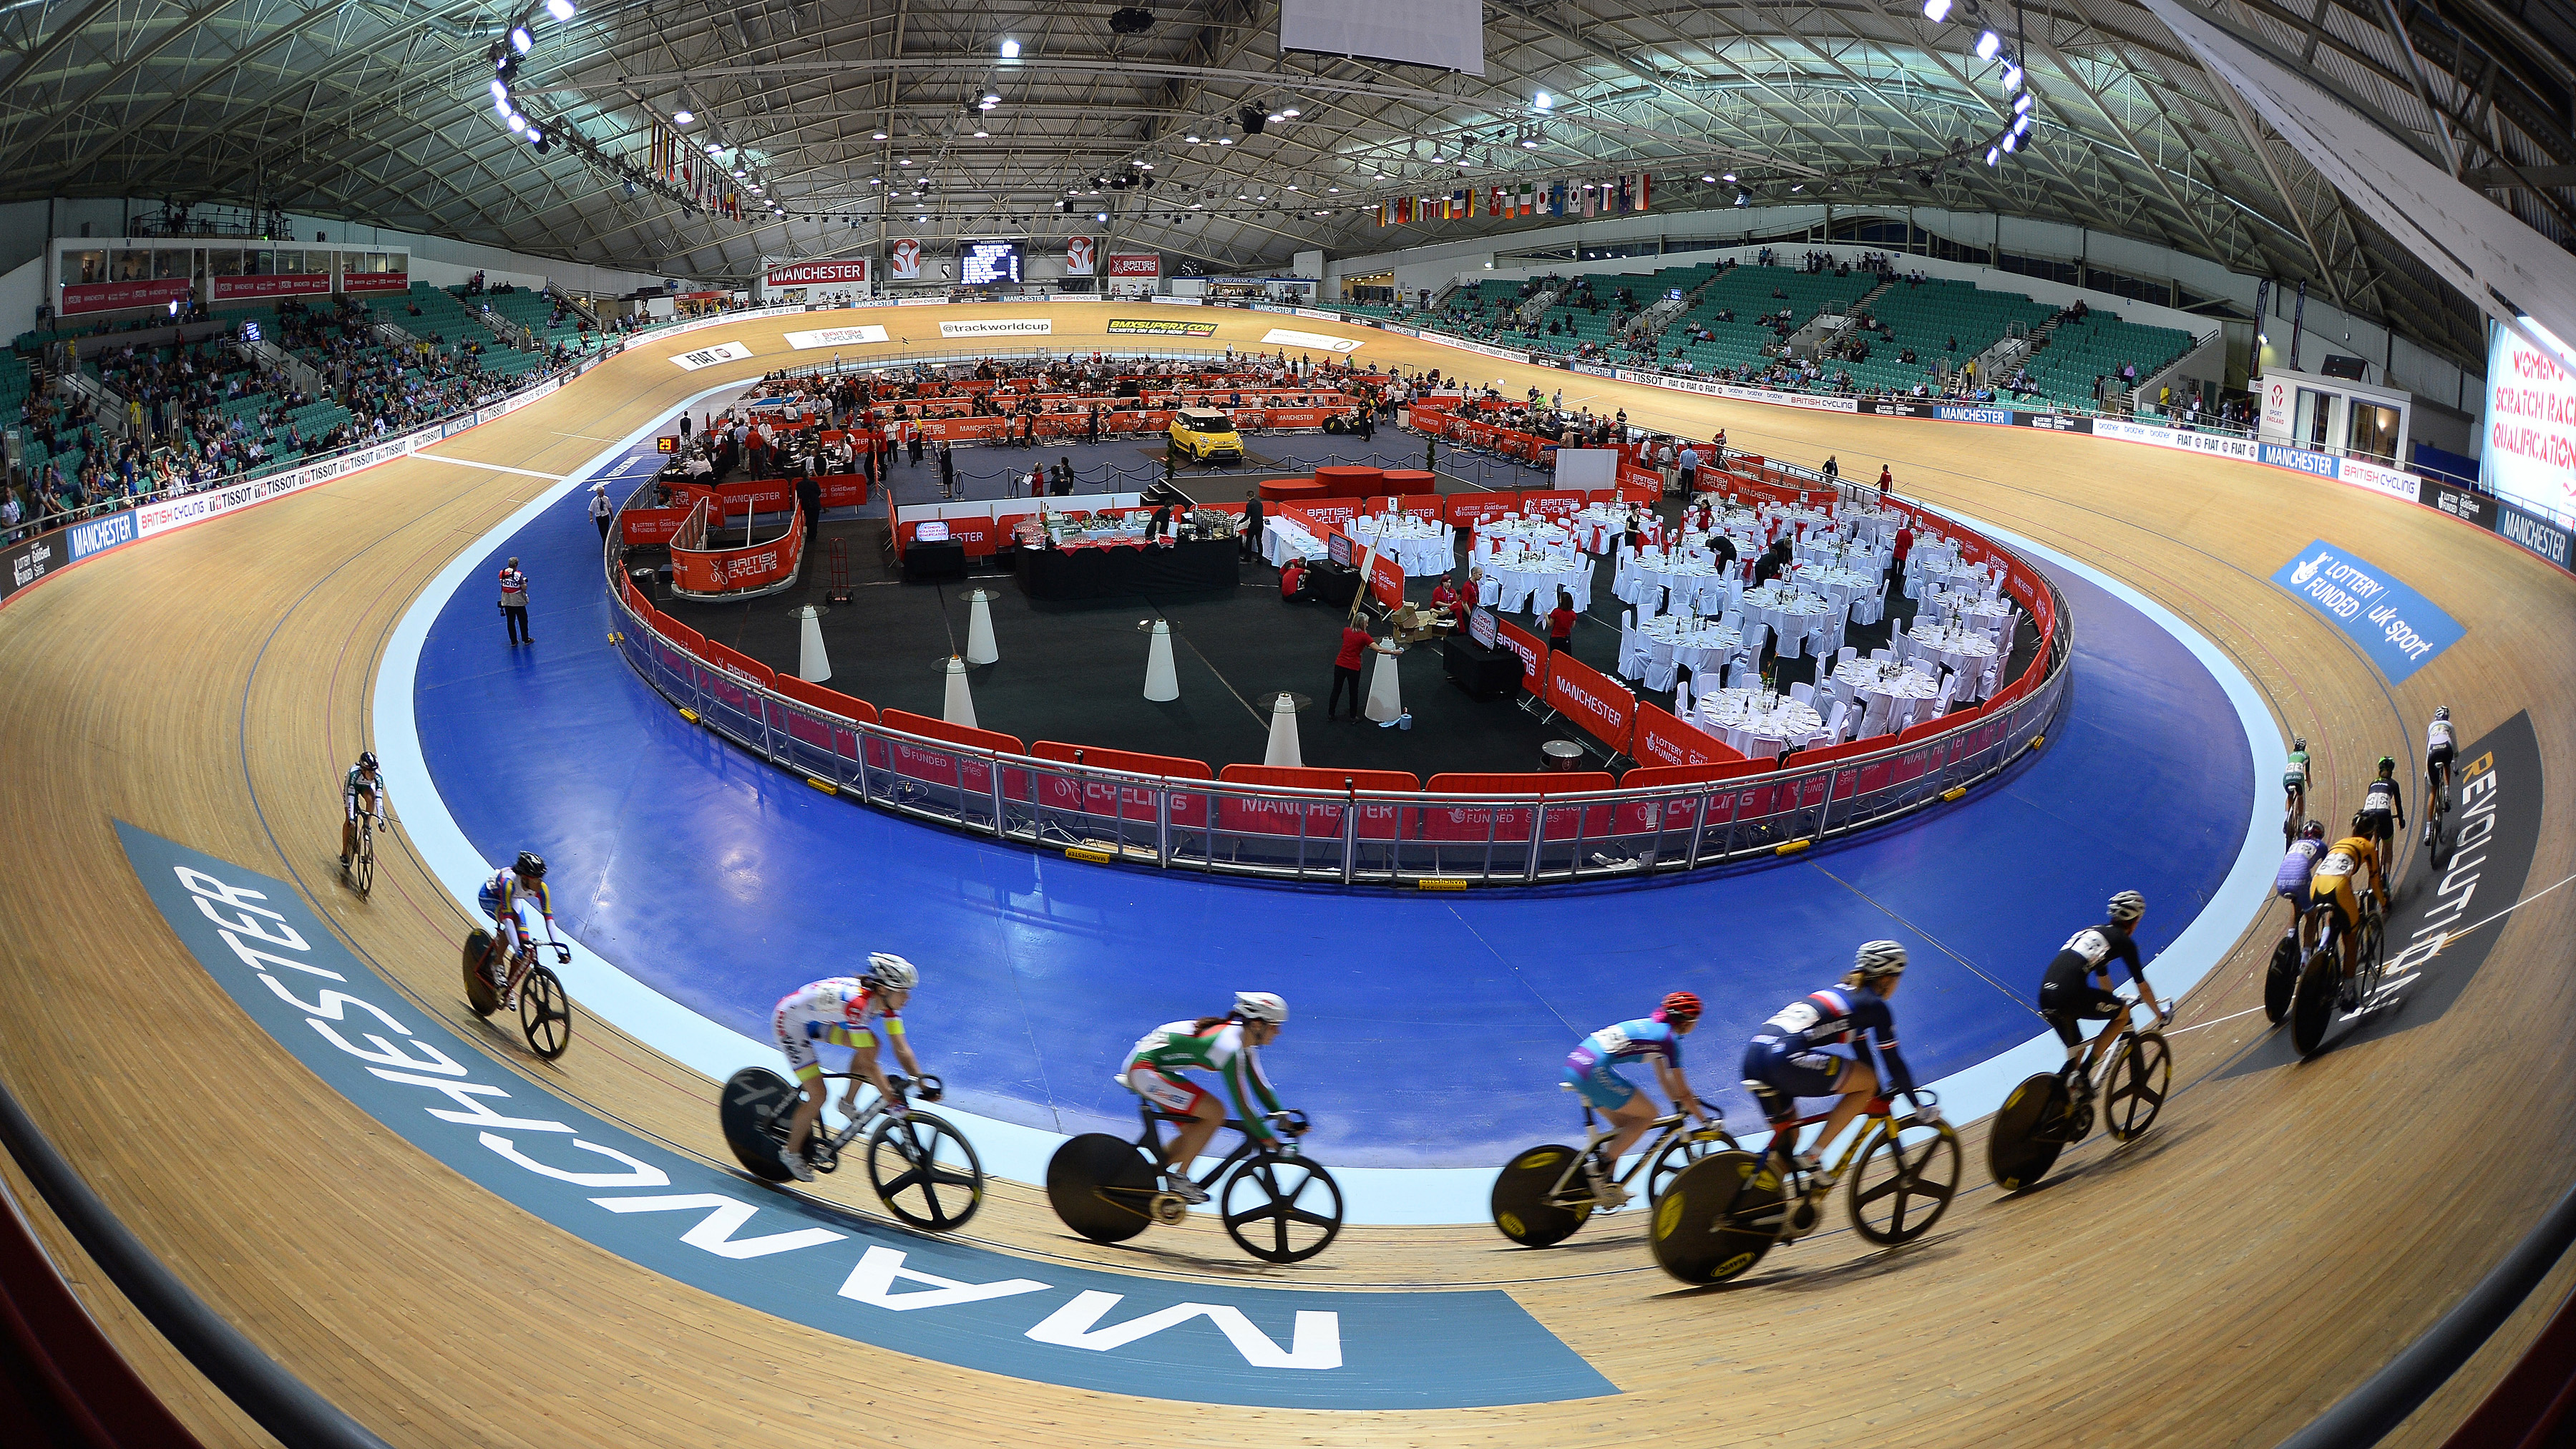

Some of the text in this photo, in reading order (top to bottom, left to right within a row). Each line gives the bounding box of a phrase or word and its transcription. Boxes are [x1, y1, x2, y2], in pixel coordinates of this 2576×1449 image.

[772, 265, 860, 281] MANCHESTER
[1254, 304, 1292, 313] MANCHESTER
[669, 326, 684, 336] TISSOT
[943, 323, 1049, 332] @trackworldcup
[1111, 321, 1215, 331] BMXSUPERX.COM
[1385, 323, 1416, 336] MANCHESTER
[1422, 333, 1438, 341] BRITISH
[686, 351, 717, 365] FIAT
[1462, 342, 1528, 361] TISSOT TISSOT TISSOT
[1574, 364, 1611, 377] MANCHESTER
[1633, 373, 1663, 386] TISSOT
[488, 402, 507, 419] TISSOT
[1791, 396, 1853, 409] BRITISH CYCLING
[2496, 386, 2544, 419] SCRATCH
[1941, 407, 2004, 423] MANCHESTER
[2266, 416, 2284, 425] ENGLAND
[444, 414, 475, 436] MANCHESTER
[2099, 422, 2170, 439] brother brother brother
[421, 429, 441, 444] TISSOT
[660, 439, 671, 450] 29
[2177, 434, 2246, 456] FIAT FIAT FIAT
[2265, 446, 2331, 475] MANCHESTER
[221, 441, 406, 508] TISSOT TISSOT TISSOT TISSOT TISSOT
[1633, 474, 1659, 486] BRITISH
[1703, 472, 1728, 486] BRITISH
[2344, 465, 2416, 494] BRITISH CYCLING
[1702, 479, 1727, 491] CYCLING
[723, 492, 780, 504] MANCHESTER
[1738, 486, 1776, 502] MANCHESTER
[2444, 493, 2458, 504] LOTTERY
[142, 500, 204, 529] BRITISH CYCLING
[1307, 507, 1353, 516] BRITISH
[2442, 502, 2469, 519] FUNDED Series
[72, 514, 132, 557] MANCHESTER
[2503, 510, 2565, 563] MANCHESTER
[728, 551, 776, 569] BRITISH
[1991, 554, 2009, 570] BRITISH
[728, 560, 777, 578] CYCLING
[2014, 575, 2034, 597] MANCHESTER
[2304, 577, 2360, 618] FUNDED
[2325, 560, 2434, 660] LOTTERY uk sport
[1496, 633, 1536, 665] BRITISH
[1556, 675, 1621, 728] MANCHESTER
[1655, 736, 1684, 758] LOTTERY
[912, 751, 947, 768] FUNDED
[1654, 746, 1682, 766] FUNDED
[1068, 852, 1106, 862] MANCHESTER
[174, 866, 1343, 1371] MANCHESTER
